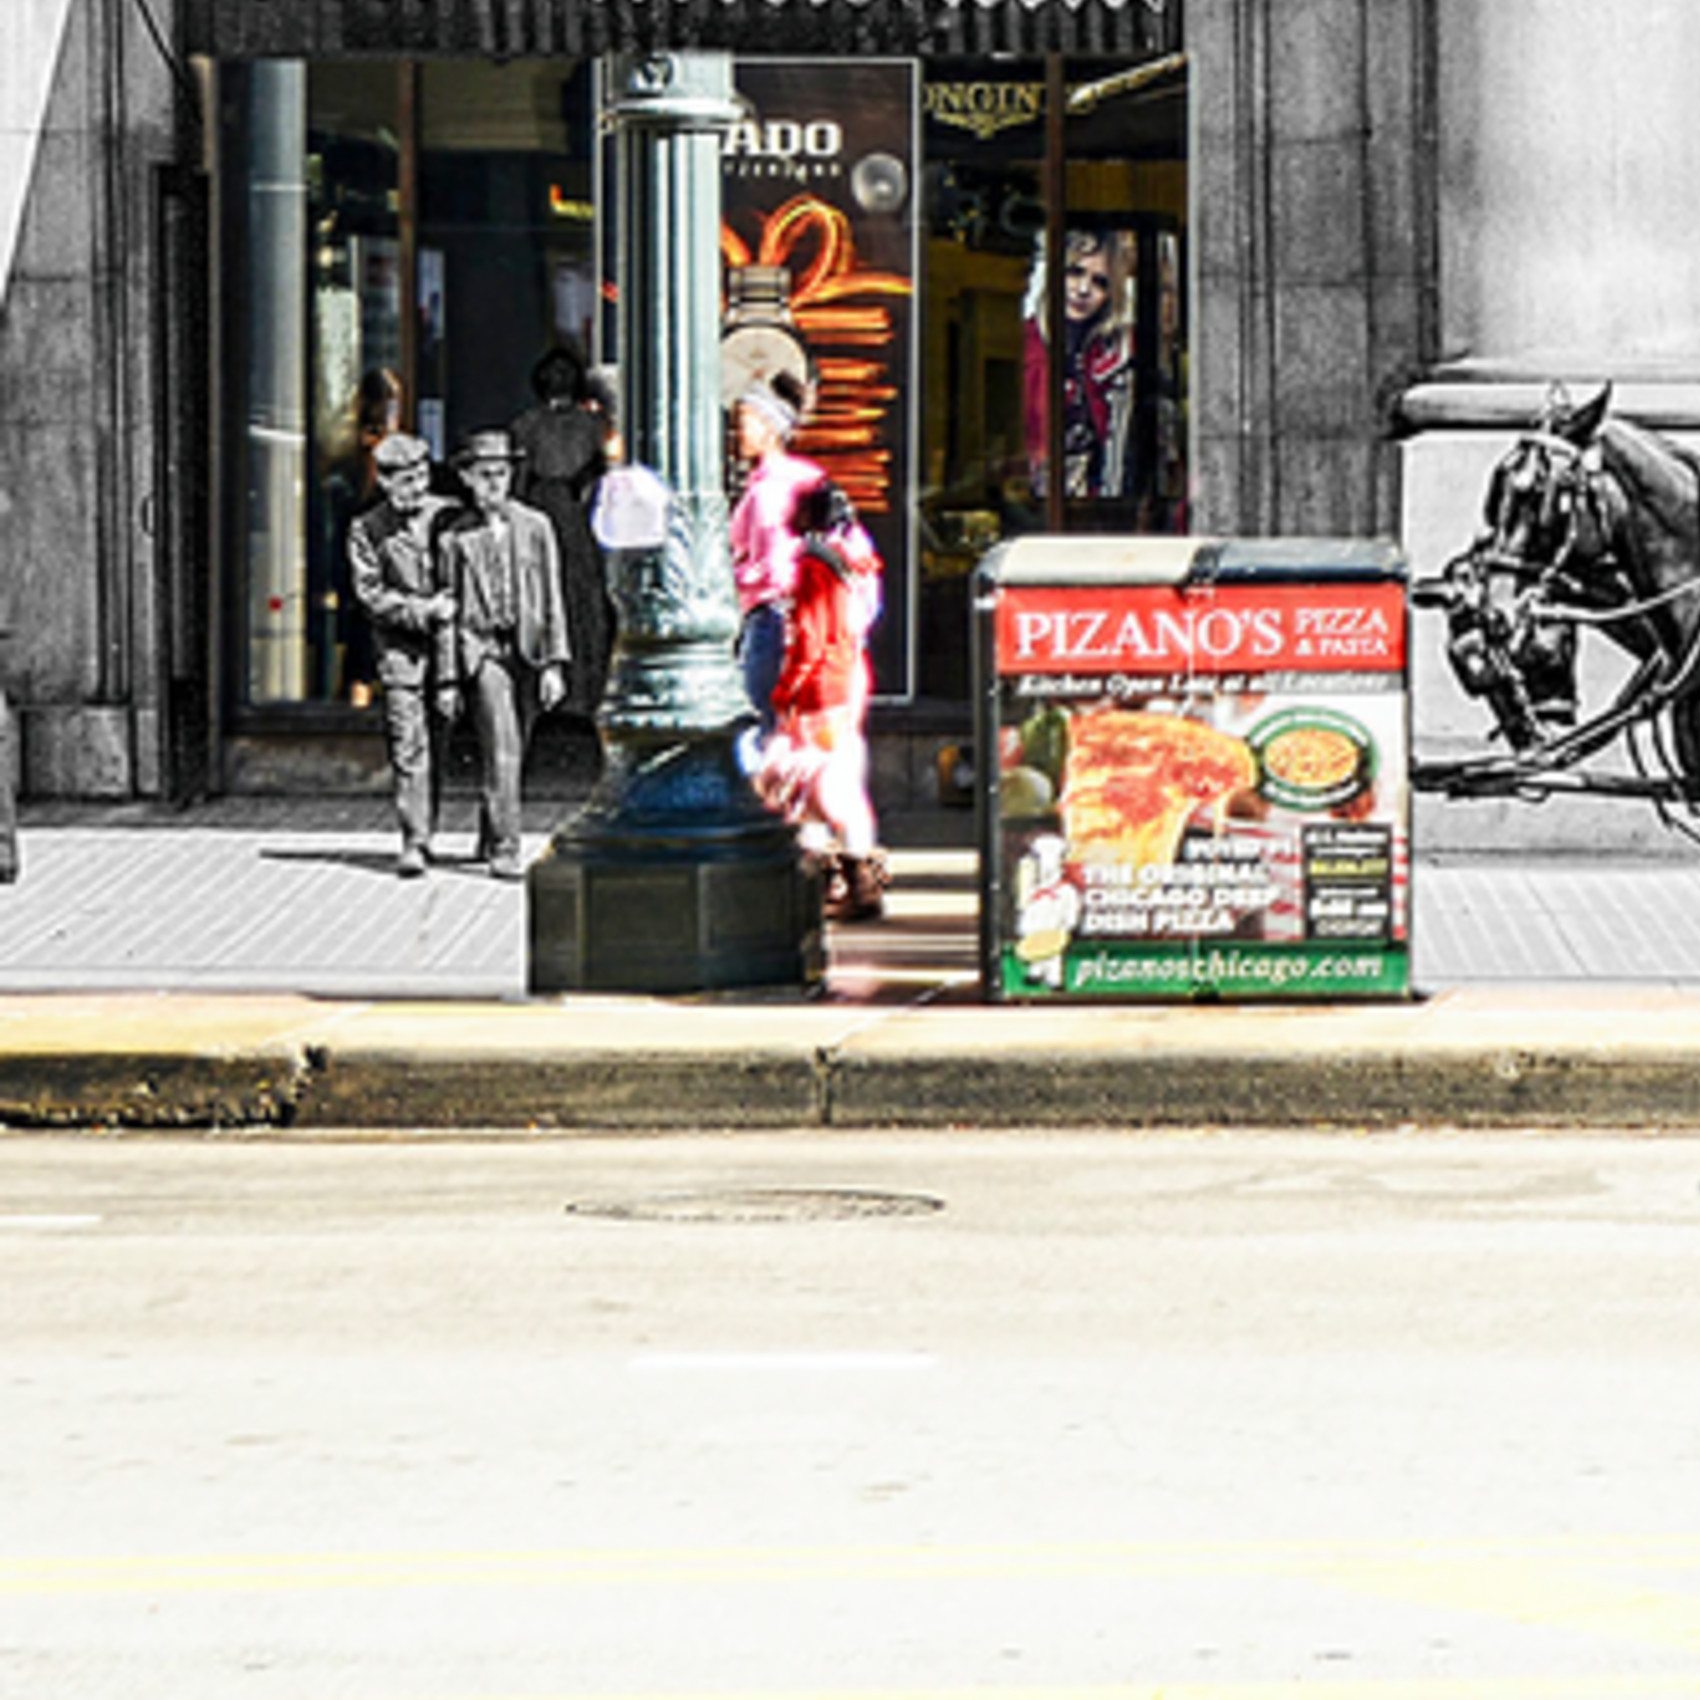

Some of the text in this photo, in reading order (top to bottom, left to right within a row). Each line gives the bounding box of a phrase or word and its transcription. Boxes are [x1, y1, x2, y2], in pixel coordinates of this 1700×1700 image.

[719, 119, 844, 157] ADO
[1014, 608, 1285, 659] PIZANO'S
[1294, 606, 1390, 635] PIZZA
[1319, 639, 1389, 657] PASTA
[1075, 950, 1383, 987] pizanoschicago.com
